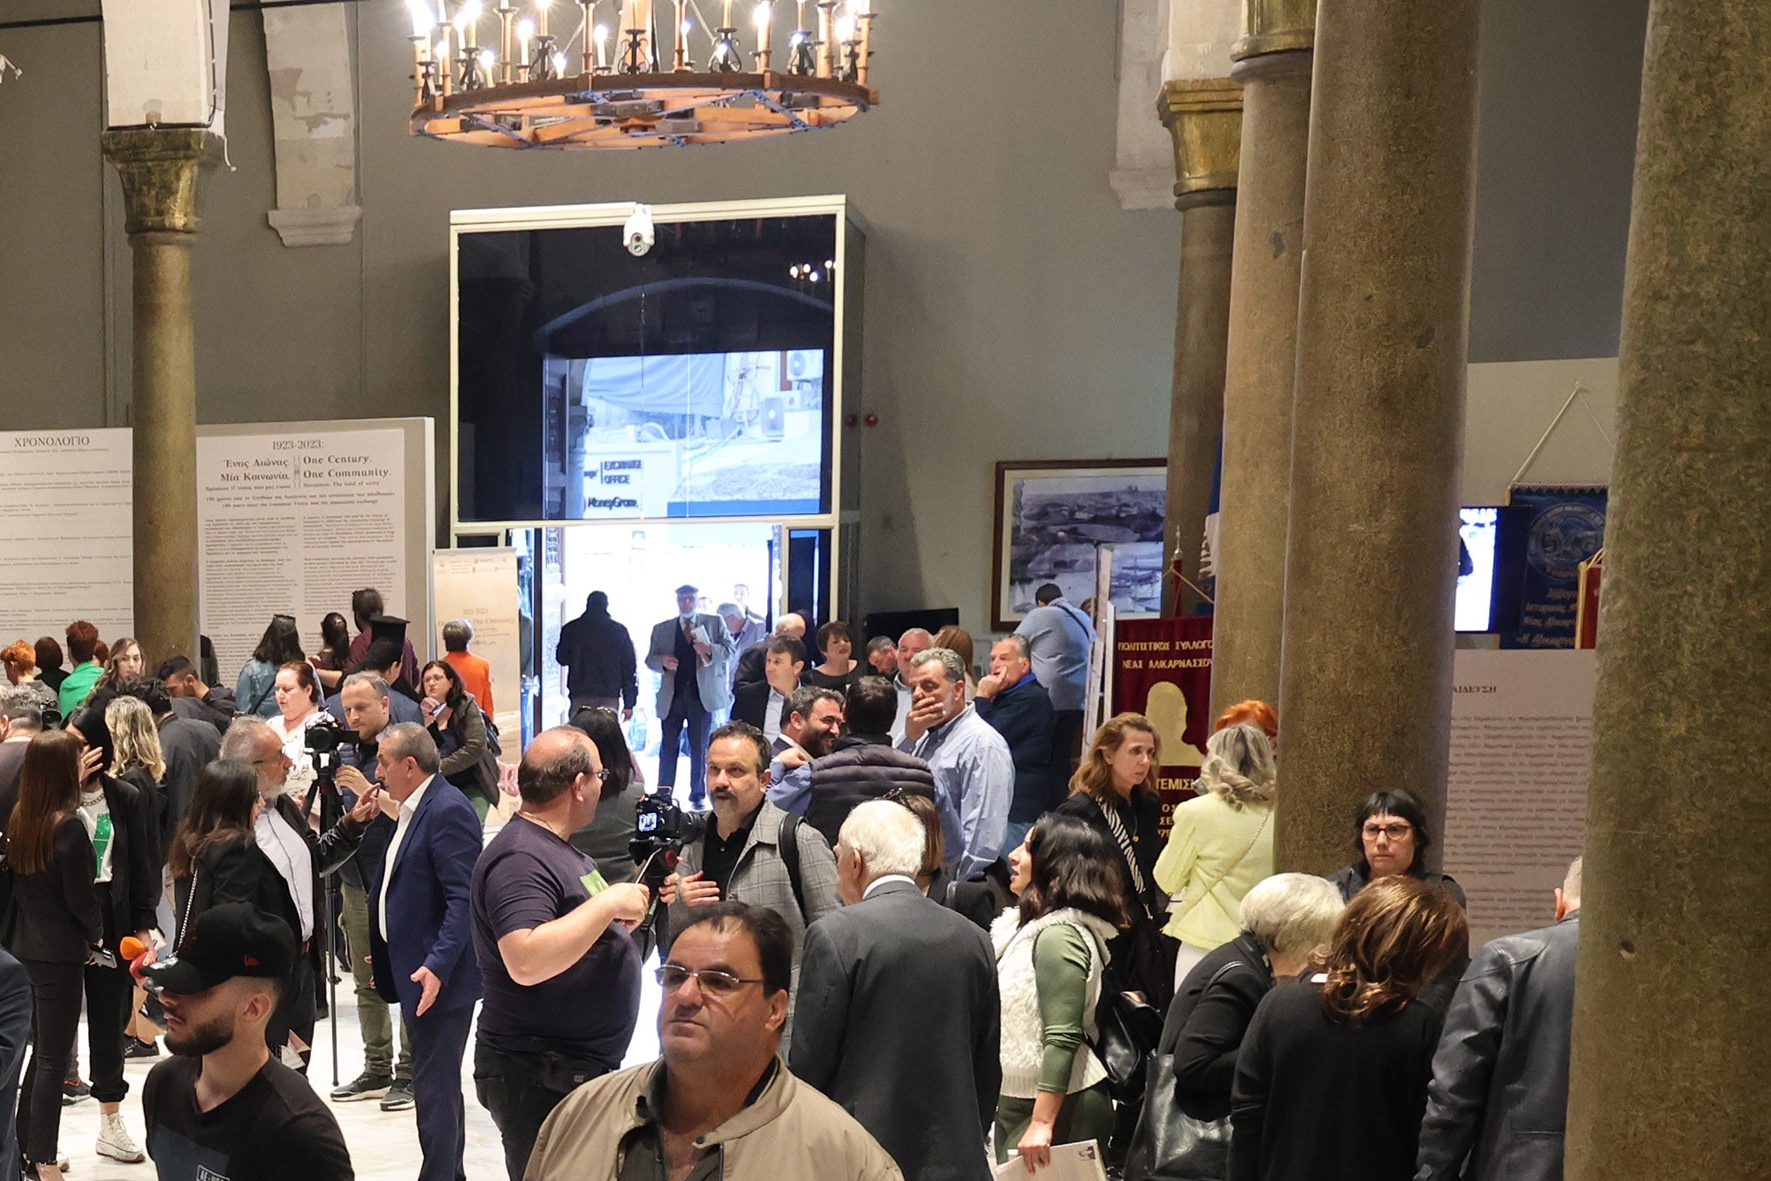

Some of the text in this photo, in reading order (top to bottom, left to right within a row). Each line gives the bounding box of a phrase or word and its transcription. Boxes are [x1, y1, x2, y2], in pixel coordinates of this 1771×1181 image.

[14, 436, 90, 447] ΧΡΟΝΟΛΟΓΙΟ
[303, 456, 324, 464] One
[220, 472, 240, 482] Μία
[303, 469, 324, 479] One
[1175, 640, 1214, 650] ΣΥΛΛΟΓΟ
